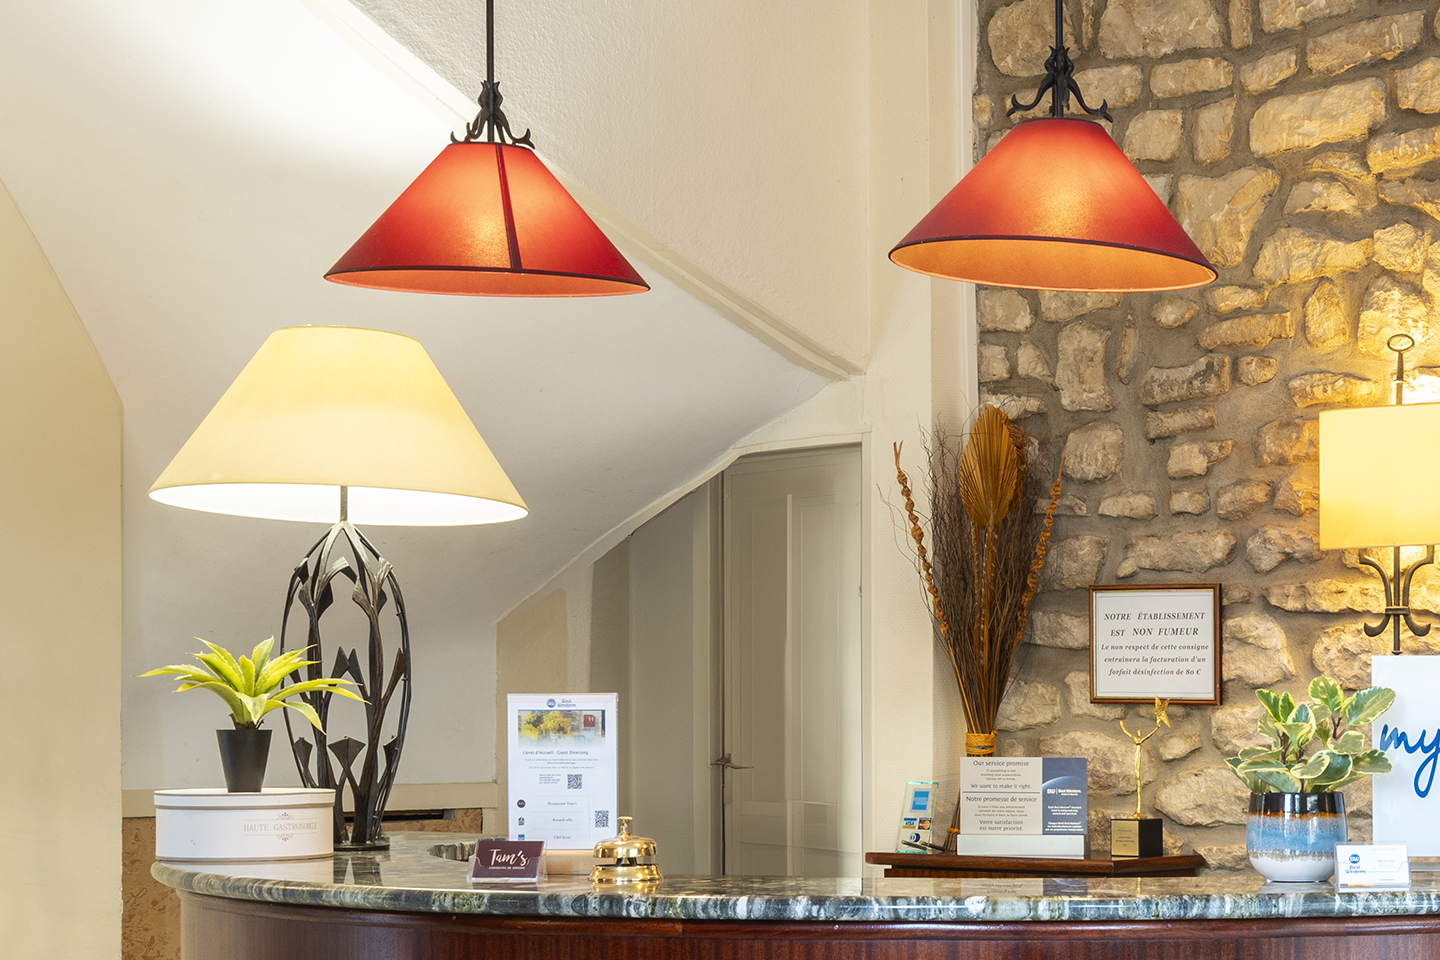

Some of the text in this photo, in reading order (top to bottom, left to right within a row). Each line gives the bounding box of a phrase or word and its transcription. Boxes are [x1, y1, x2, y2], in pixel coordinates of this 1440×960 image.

[1137, 612, 1206, 620] ÉTABLISSEMENT
[1110, 628, 1199, 637] EST NON FUMEUR
[1149, 656, 1189, 664] facturation
[243, 822, 318, 832] HAUTE GASTRONOMIE
[489, 848, 528, 867] Tam's
